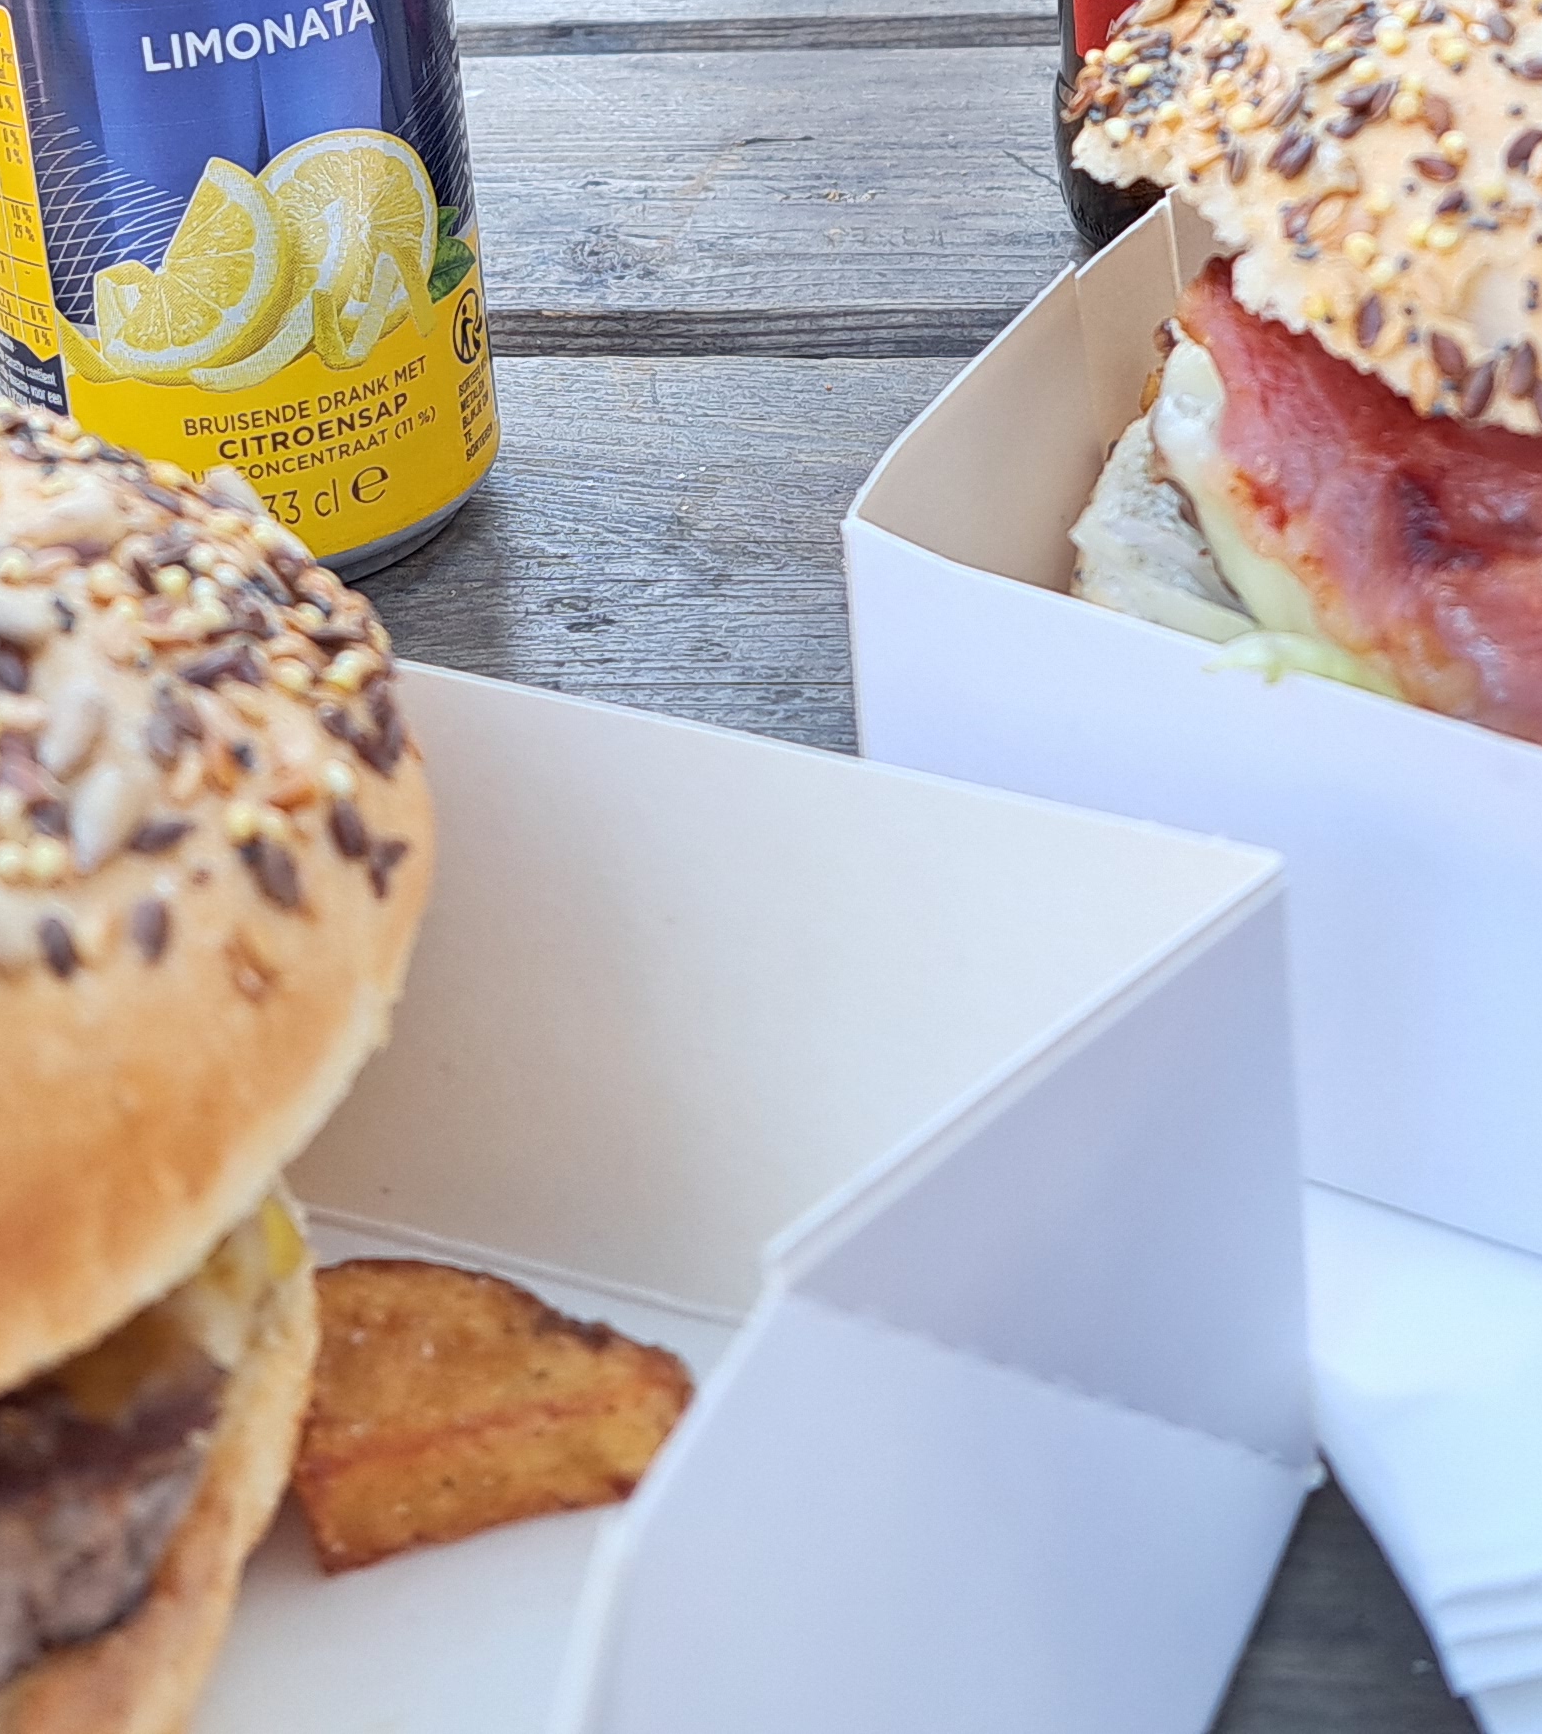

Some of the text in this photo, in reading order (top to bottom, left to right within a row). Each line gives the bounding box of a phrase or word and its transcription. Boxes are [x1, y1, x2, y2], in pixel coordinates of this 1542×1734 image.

[184, 399, 312, 436] BRUISENDE
[318, 375, 389, 415] DRANK
[394, 355, 427, 387] MET
[418, 406, 437, 426] %)
[219, 392, 408, 459] CITROENSAP
[261, 490, 301, 525] 33
[315, 479, 340, 517] cl
